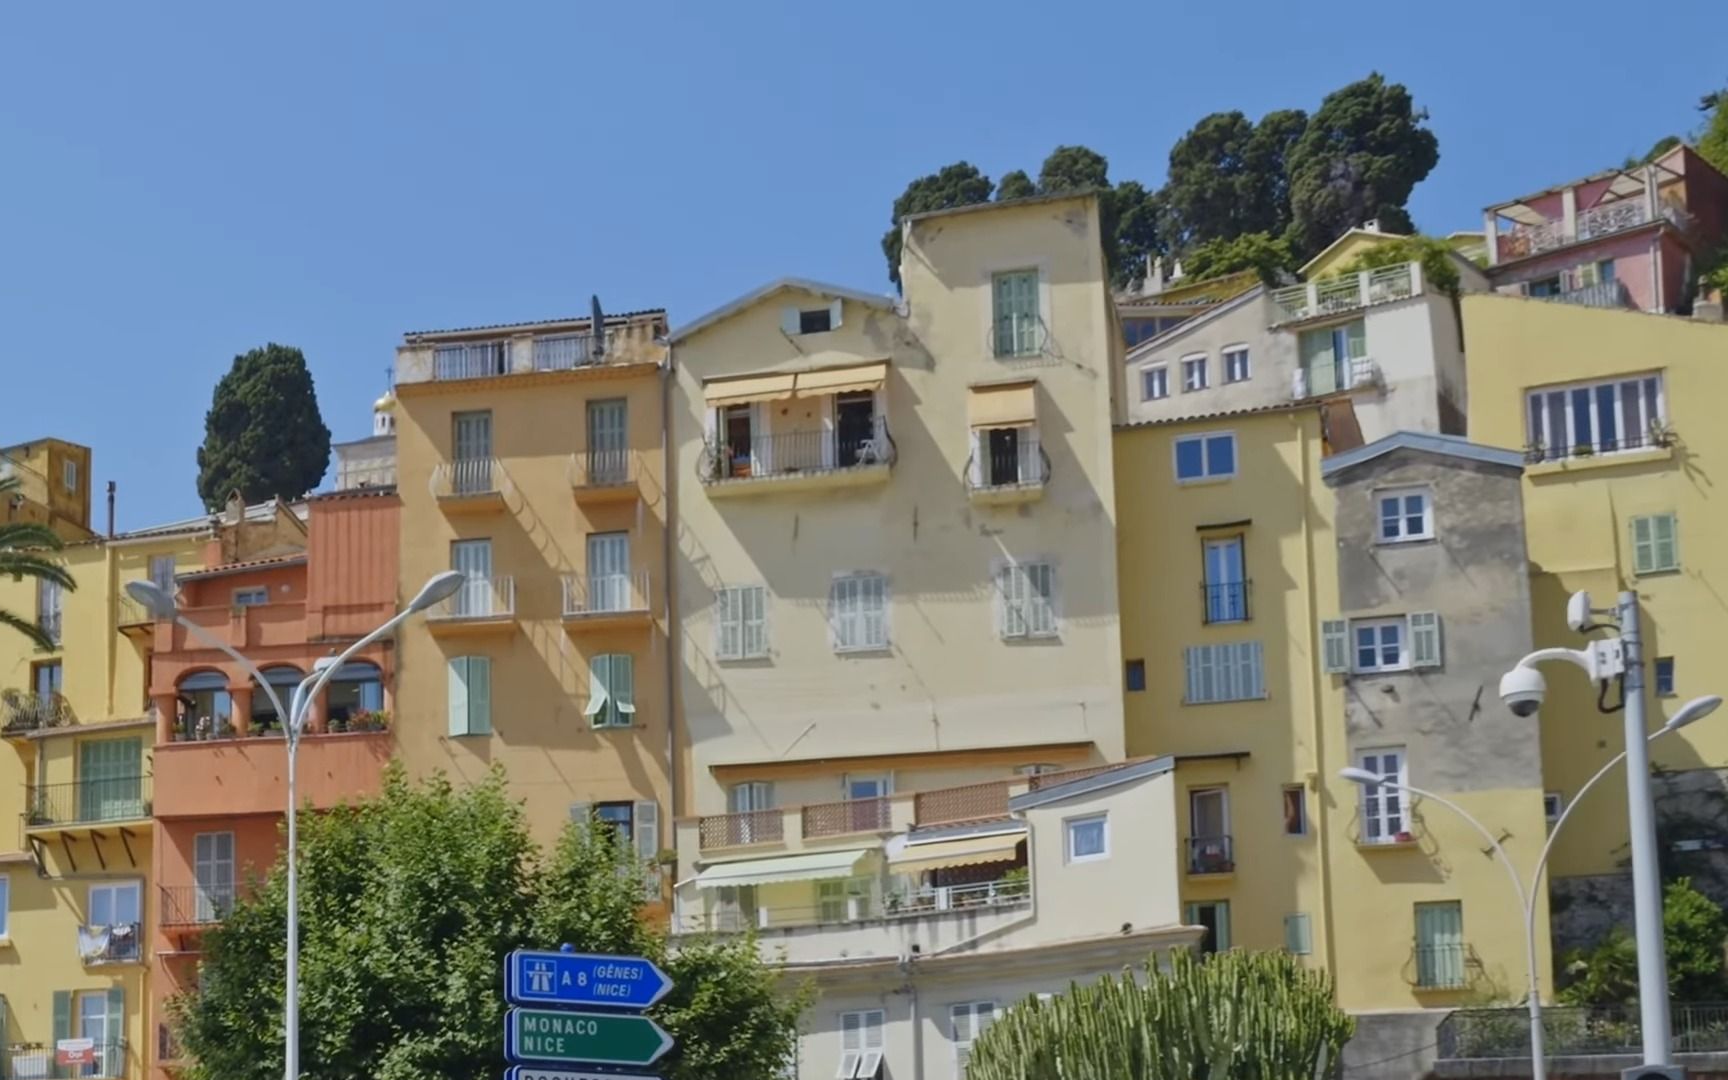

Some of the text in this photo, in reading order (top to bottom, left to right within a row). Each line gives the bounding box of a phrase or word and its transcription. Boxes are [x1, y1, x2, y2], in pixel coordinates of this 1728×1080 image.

[561, 970, 588, 986] A 8
[592, 964, 644, 981] (GÊNES)
[592, 983, 632, 997] (NICE)
[524, 1017, 598, 1035] MONACO
[524, 1036, 565, 1052] NICE
